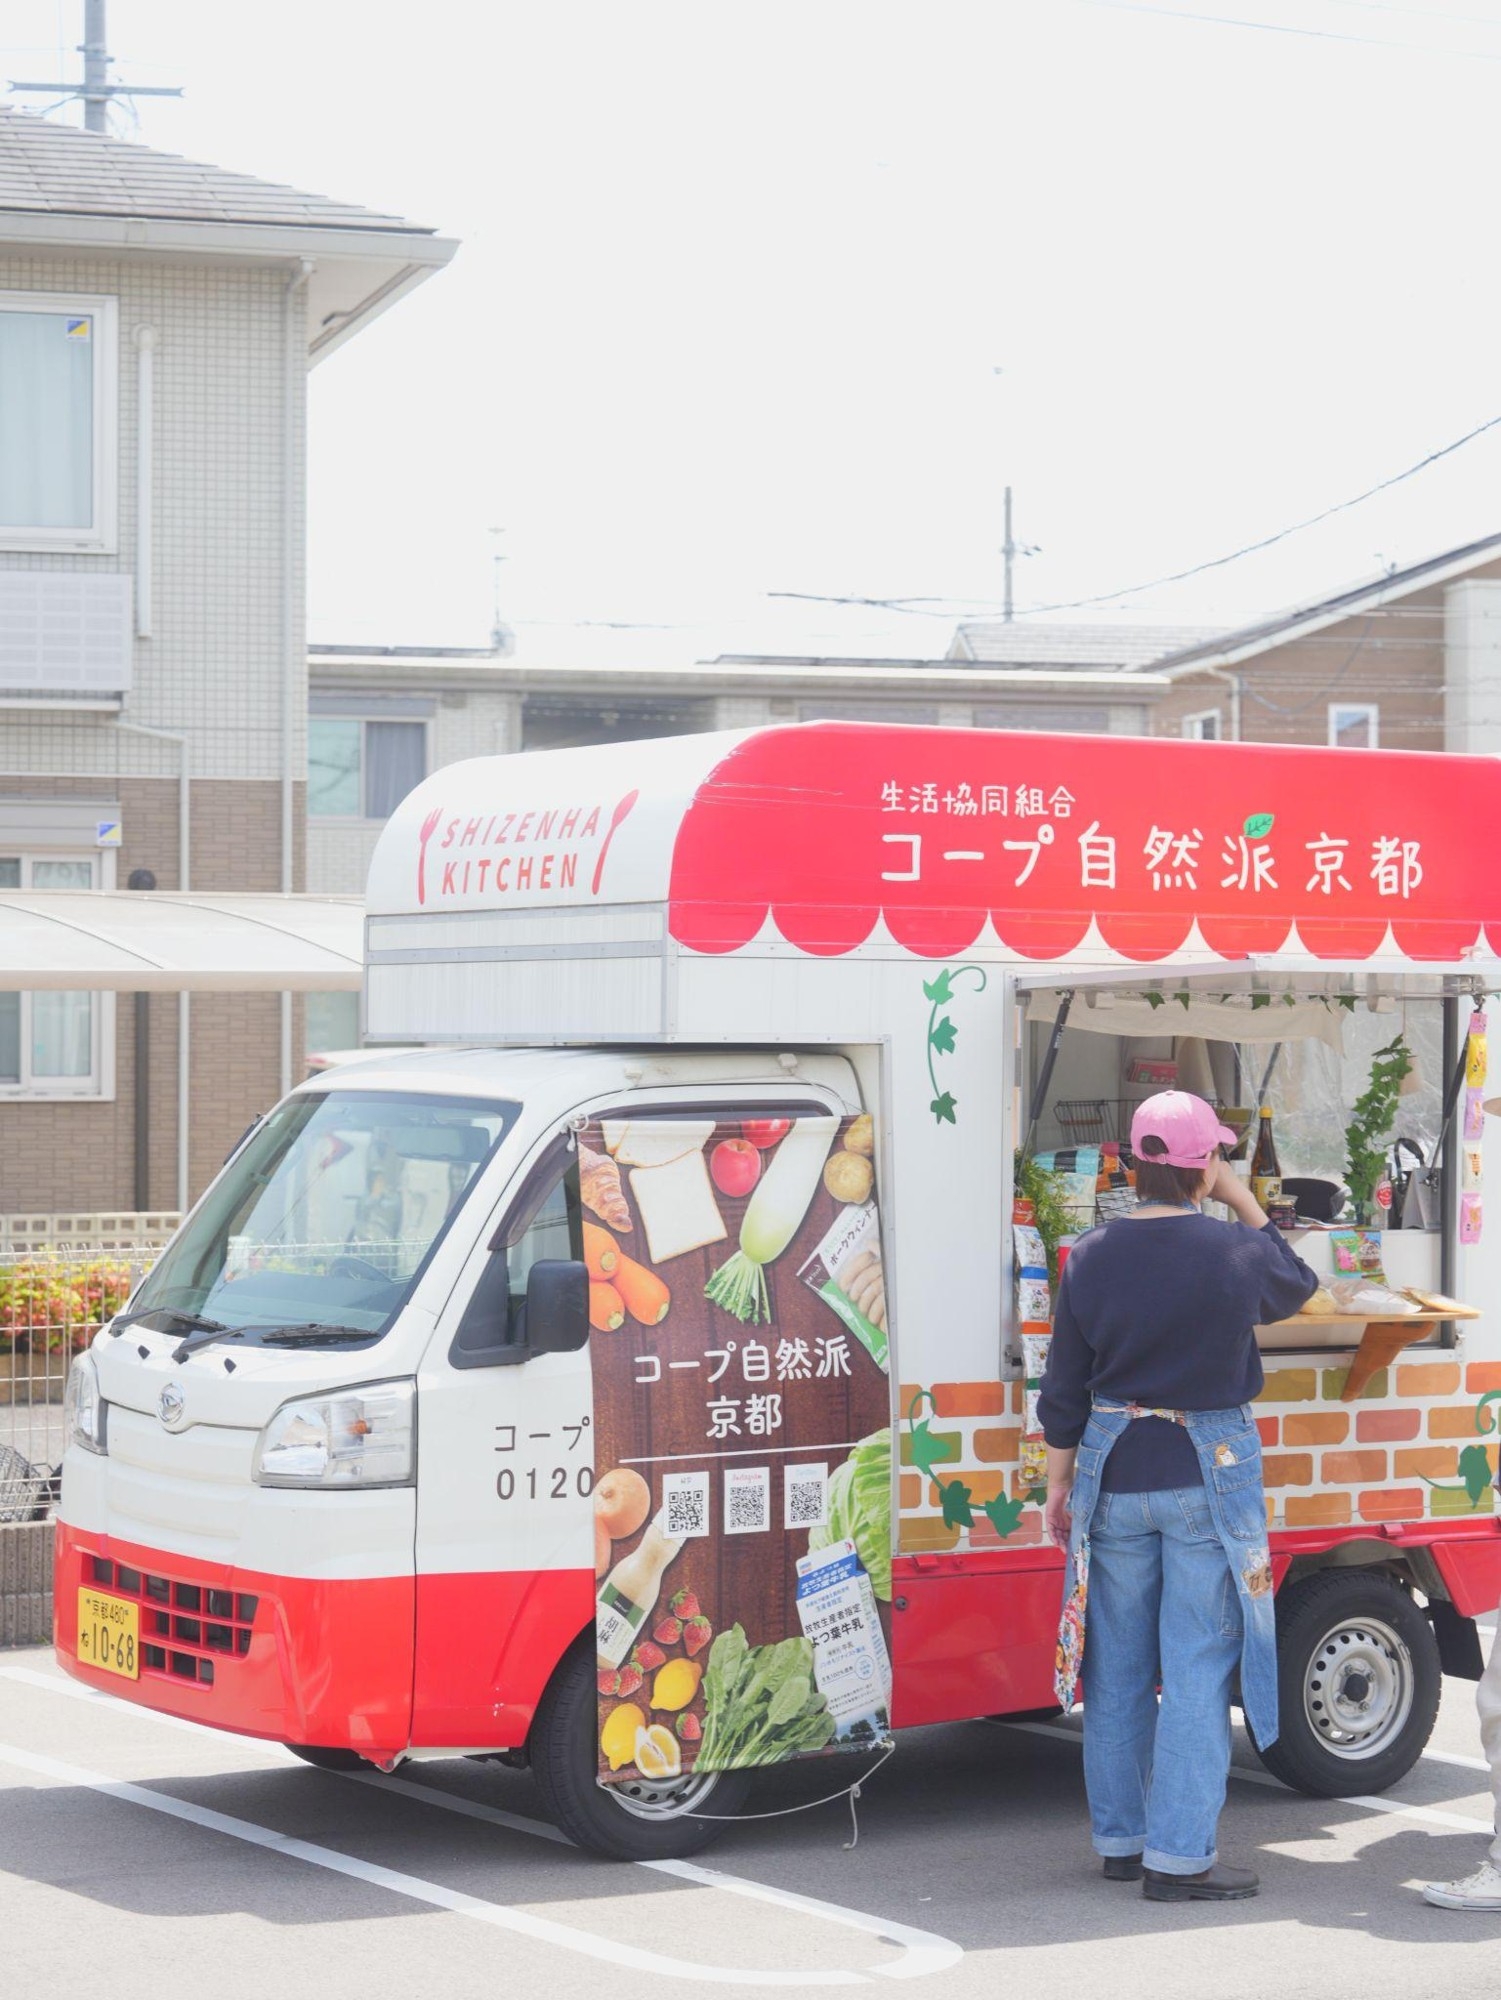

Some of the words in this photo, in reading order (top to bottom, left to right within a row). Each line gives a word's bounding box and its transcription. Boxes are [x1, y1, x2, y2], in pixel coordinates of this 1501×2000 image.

[881, 780, 1076, 818] 生活協同組合
[441, 806, 601, 848] SHIZENHA
[442, 853, 577, 895] KITCHEN
[881, 821, 1424, 898] コープ自然派京都
[634, 1335, 852, 1383] コープ自然派
[495, 1416, 590, 1451] コープ
[706, 1394, 782, 1439] 京都
[497, 1466, 595, 1500] 0120
[811, 1617, 864, 1649] よつ葉牛乳
